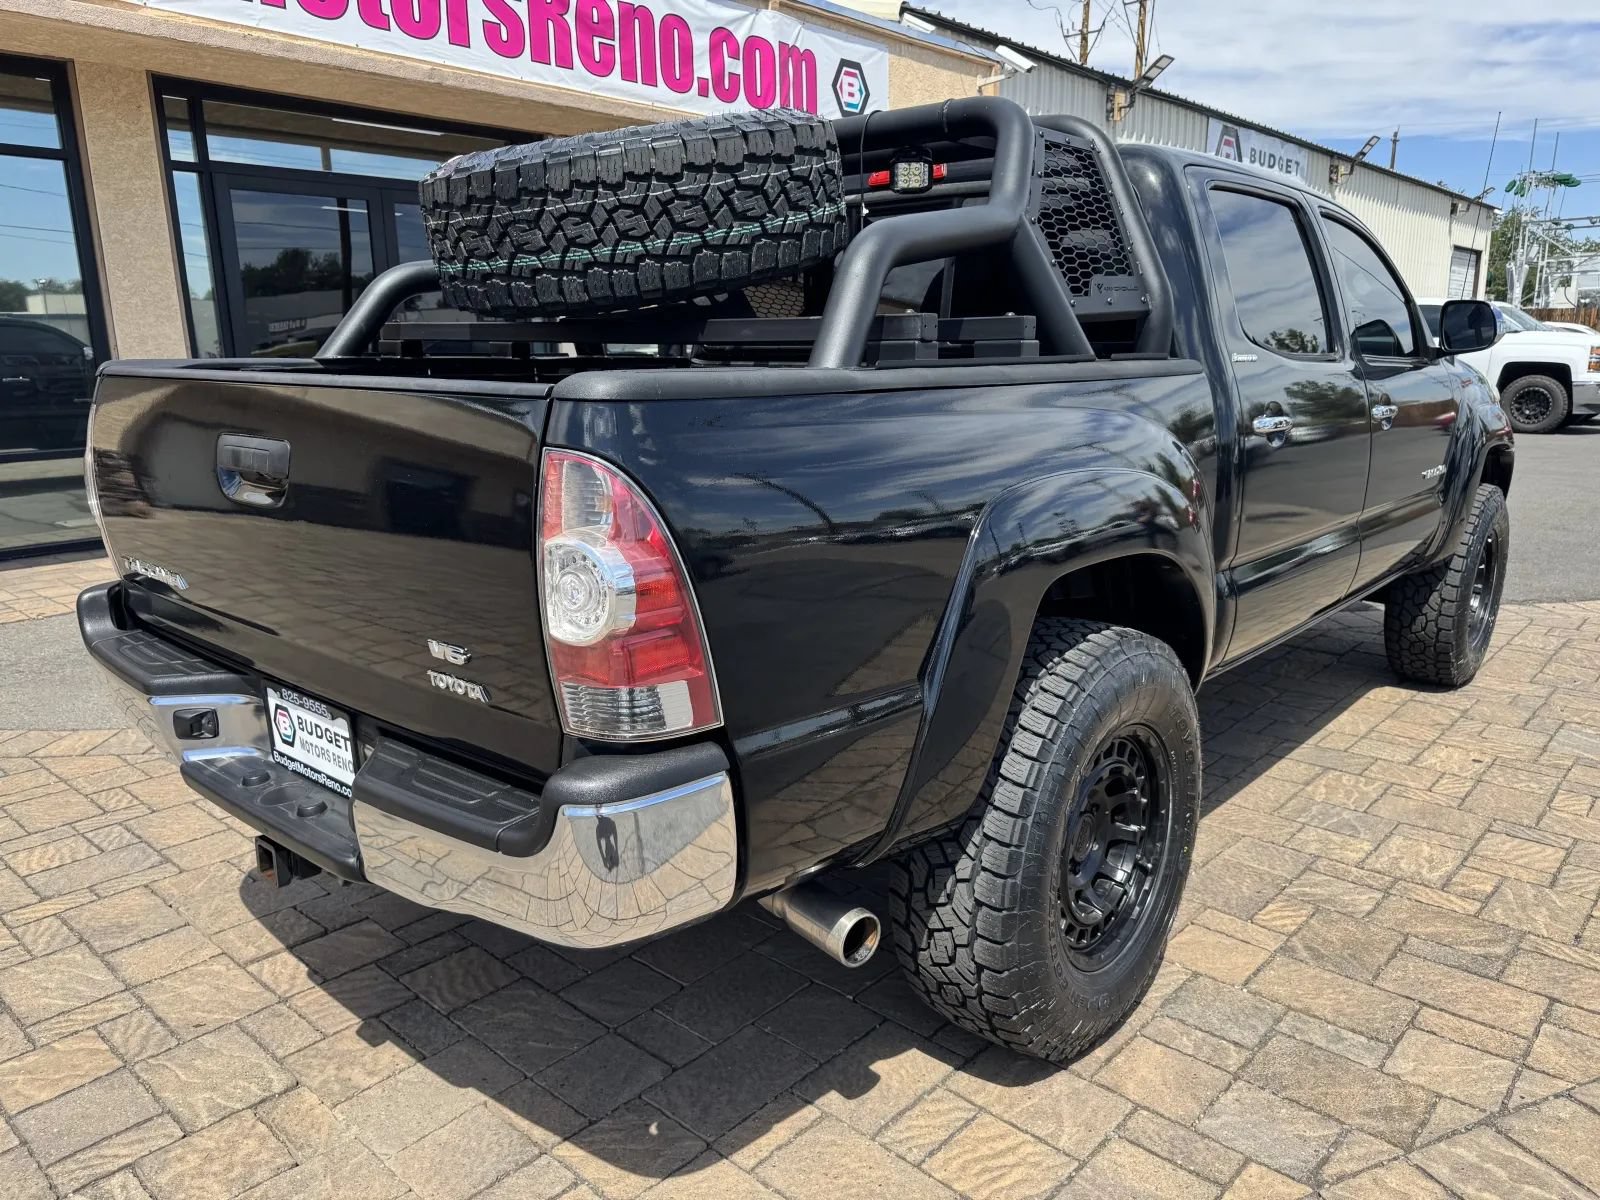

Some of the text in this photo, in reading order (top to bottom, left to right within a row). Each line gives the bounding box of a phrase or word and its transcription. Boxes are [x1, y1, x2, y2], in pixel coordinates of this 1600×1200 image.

[1249, 148, 1300, 176] BUDGET
[427, 638, 471, 666] V6
[281, 688, 328, 717] 825-9555
[427, 669, 491, 704] TOYOTA
[296, 714, 351, 752] BUDGET
[298, 736, 354, 773] MOTORS RENO
[273, 751, 352, 798] BudgetMotorsReno.co
